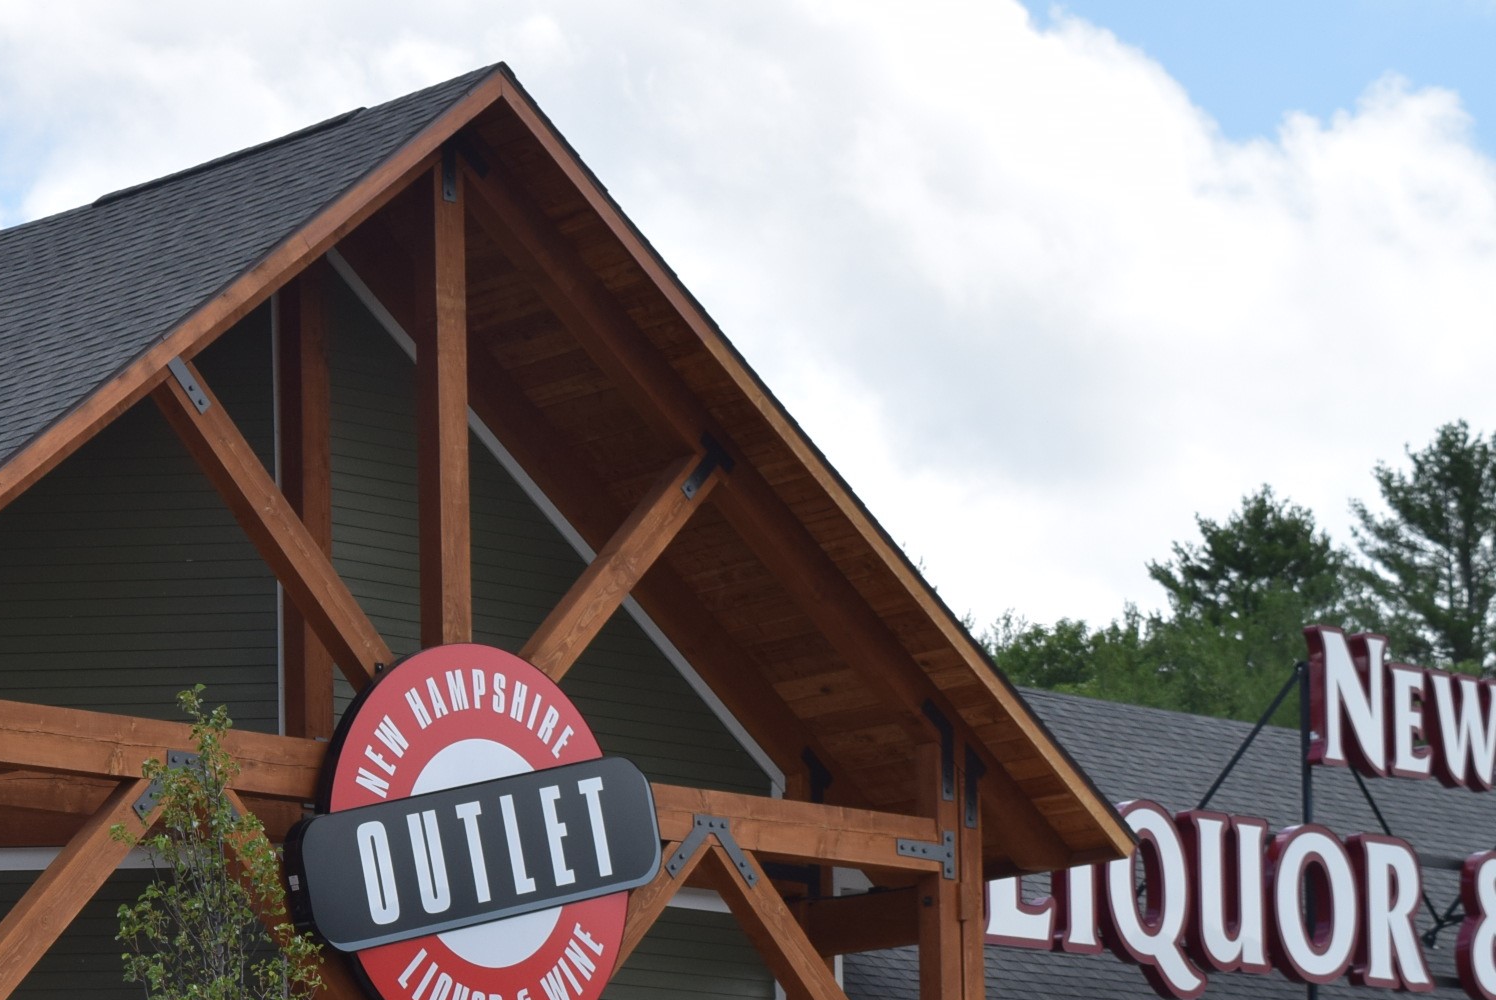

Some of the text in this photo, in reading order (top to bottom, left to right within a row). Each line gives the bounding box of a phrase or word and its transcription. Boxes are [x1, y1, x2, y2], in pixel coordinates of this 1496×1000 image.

[355, 669, 574, 798] NEW HAMPSHIRE
[356, 776, 614, 926] OUTLET
